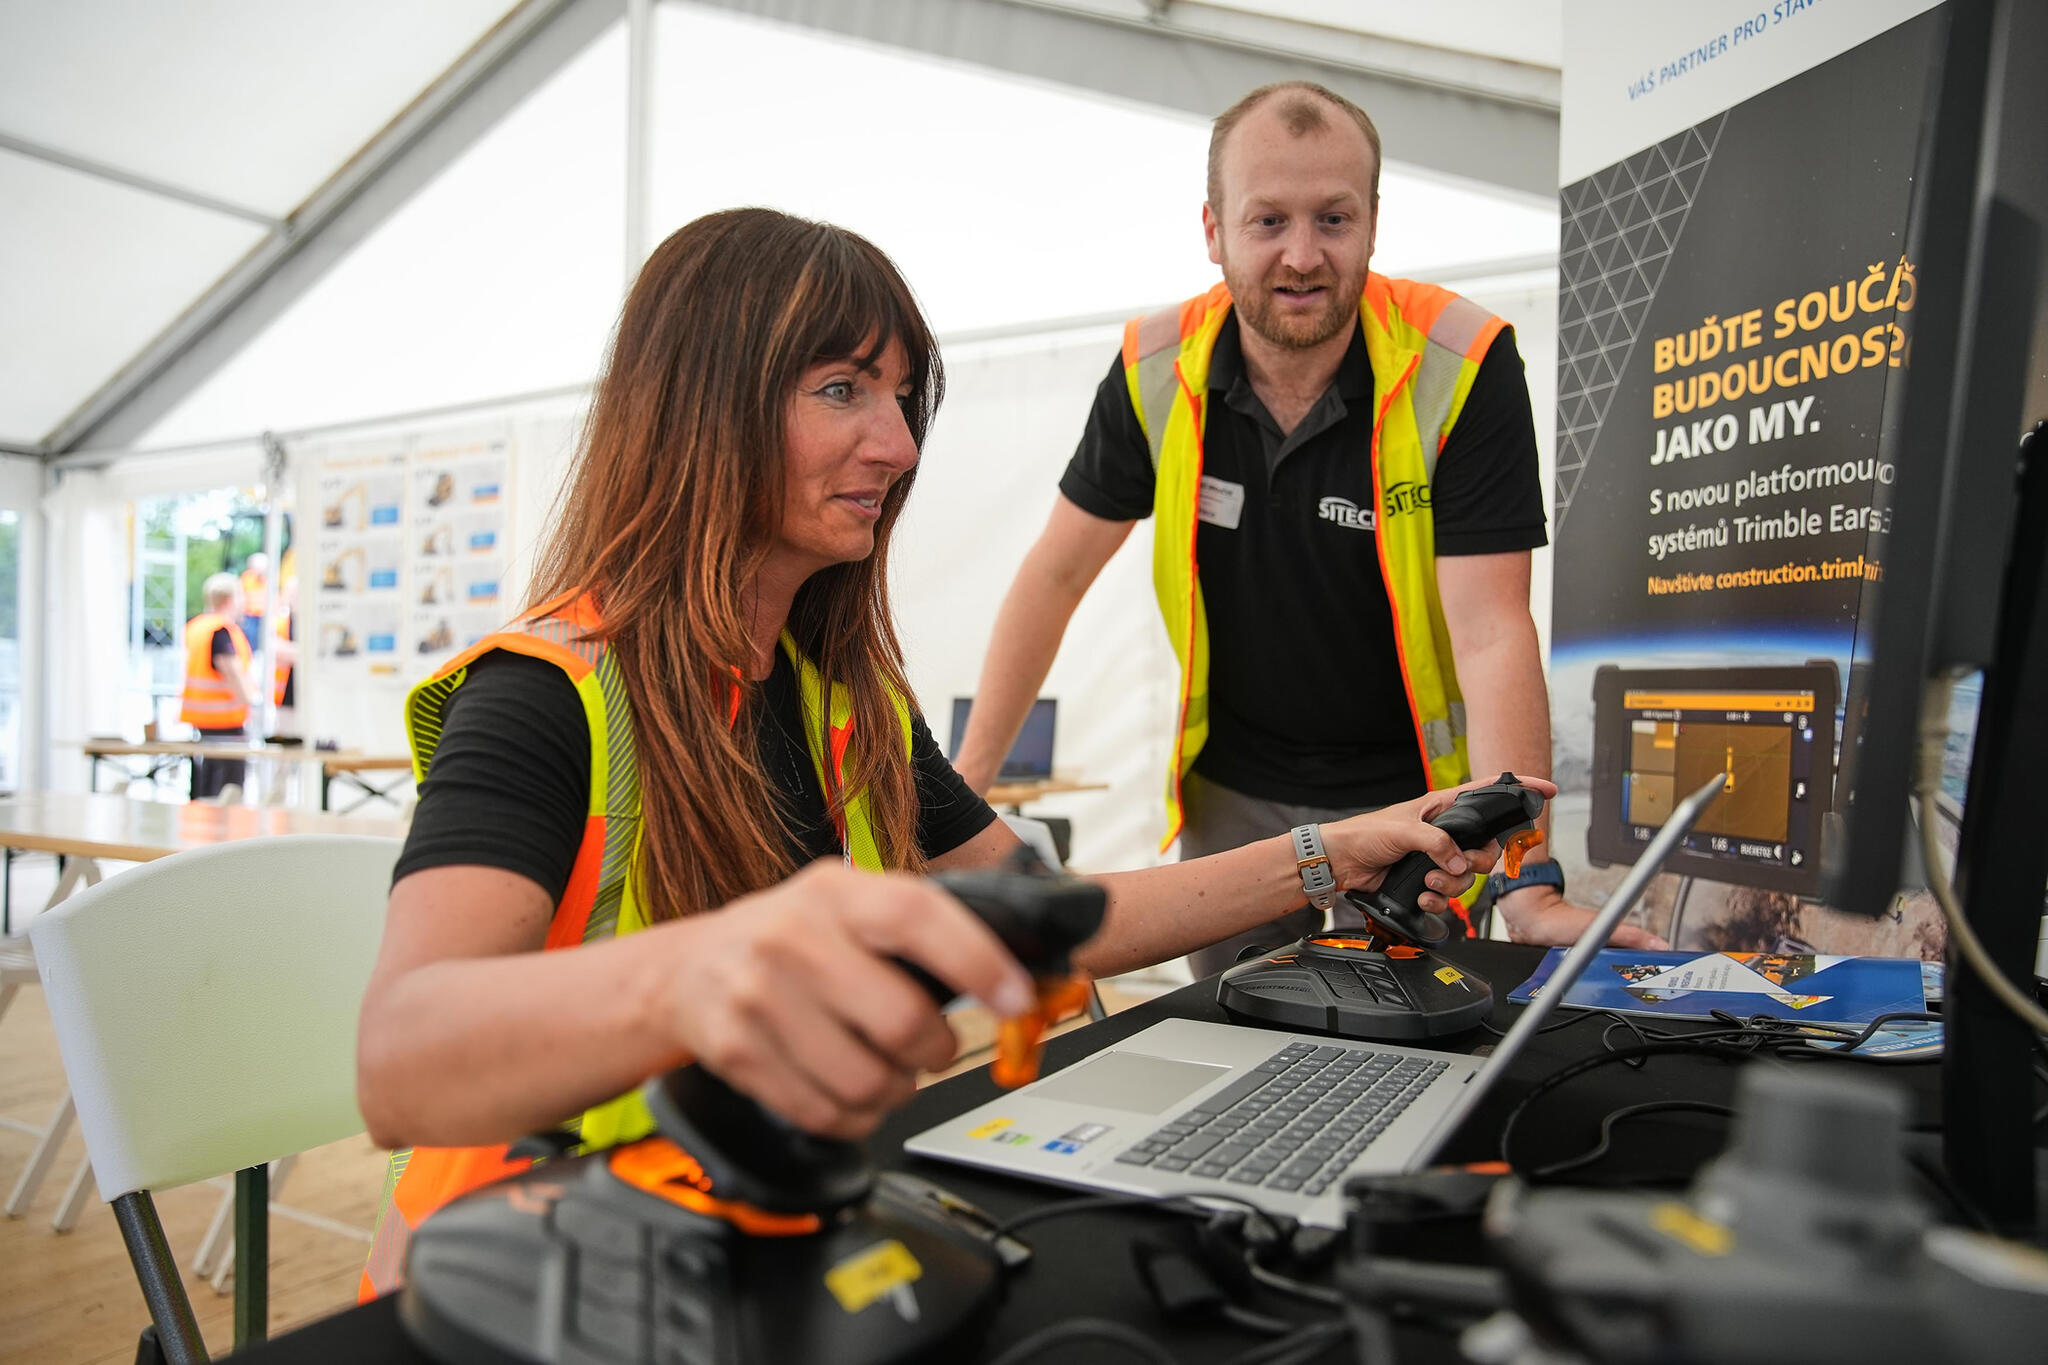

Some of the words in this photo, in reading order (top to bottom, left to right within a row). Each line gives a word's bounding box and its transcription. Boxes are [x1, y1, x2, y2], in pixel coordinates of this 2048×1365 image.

[1660, 34, 1729, 85] PARTNER
[1733, 13, 1768, 46] PRO
[1773, 0, 1814, 25] STA
[1654, 308, 1763, 374] BUĎTE
[1650, 413, 1739, 465] JAKO
[1749, 396, 1821, 445] MY.
[1650, 488, 1662, 515] S
[1667, 482, 1730, 512] novou
[1735, 458, 1874, 507] platformou
[1648, 518, 1728, 561] systémů
[1733, 507, 1822, 544] Trimble
